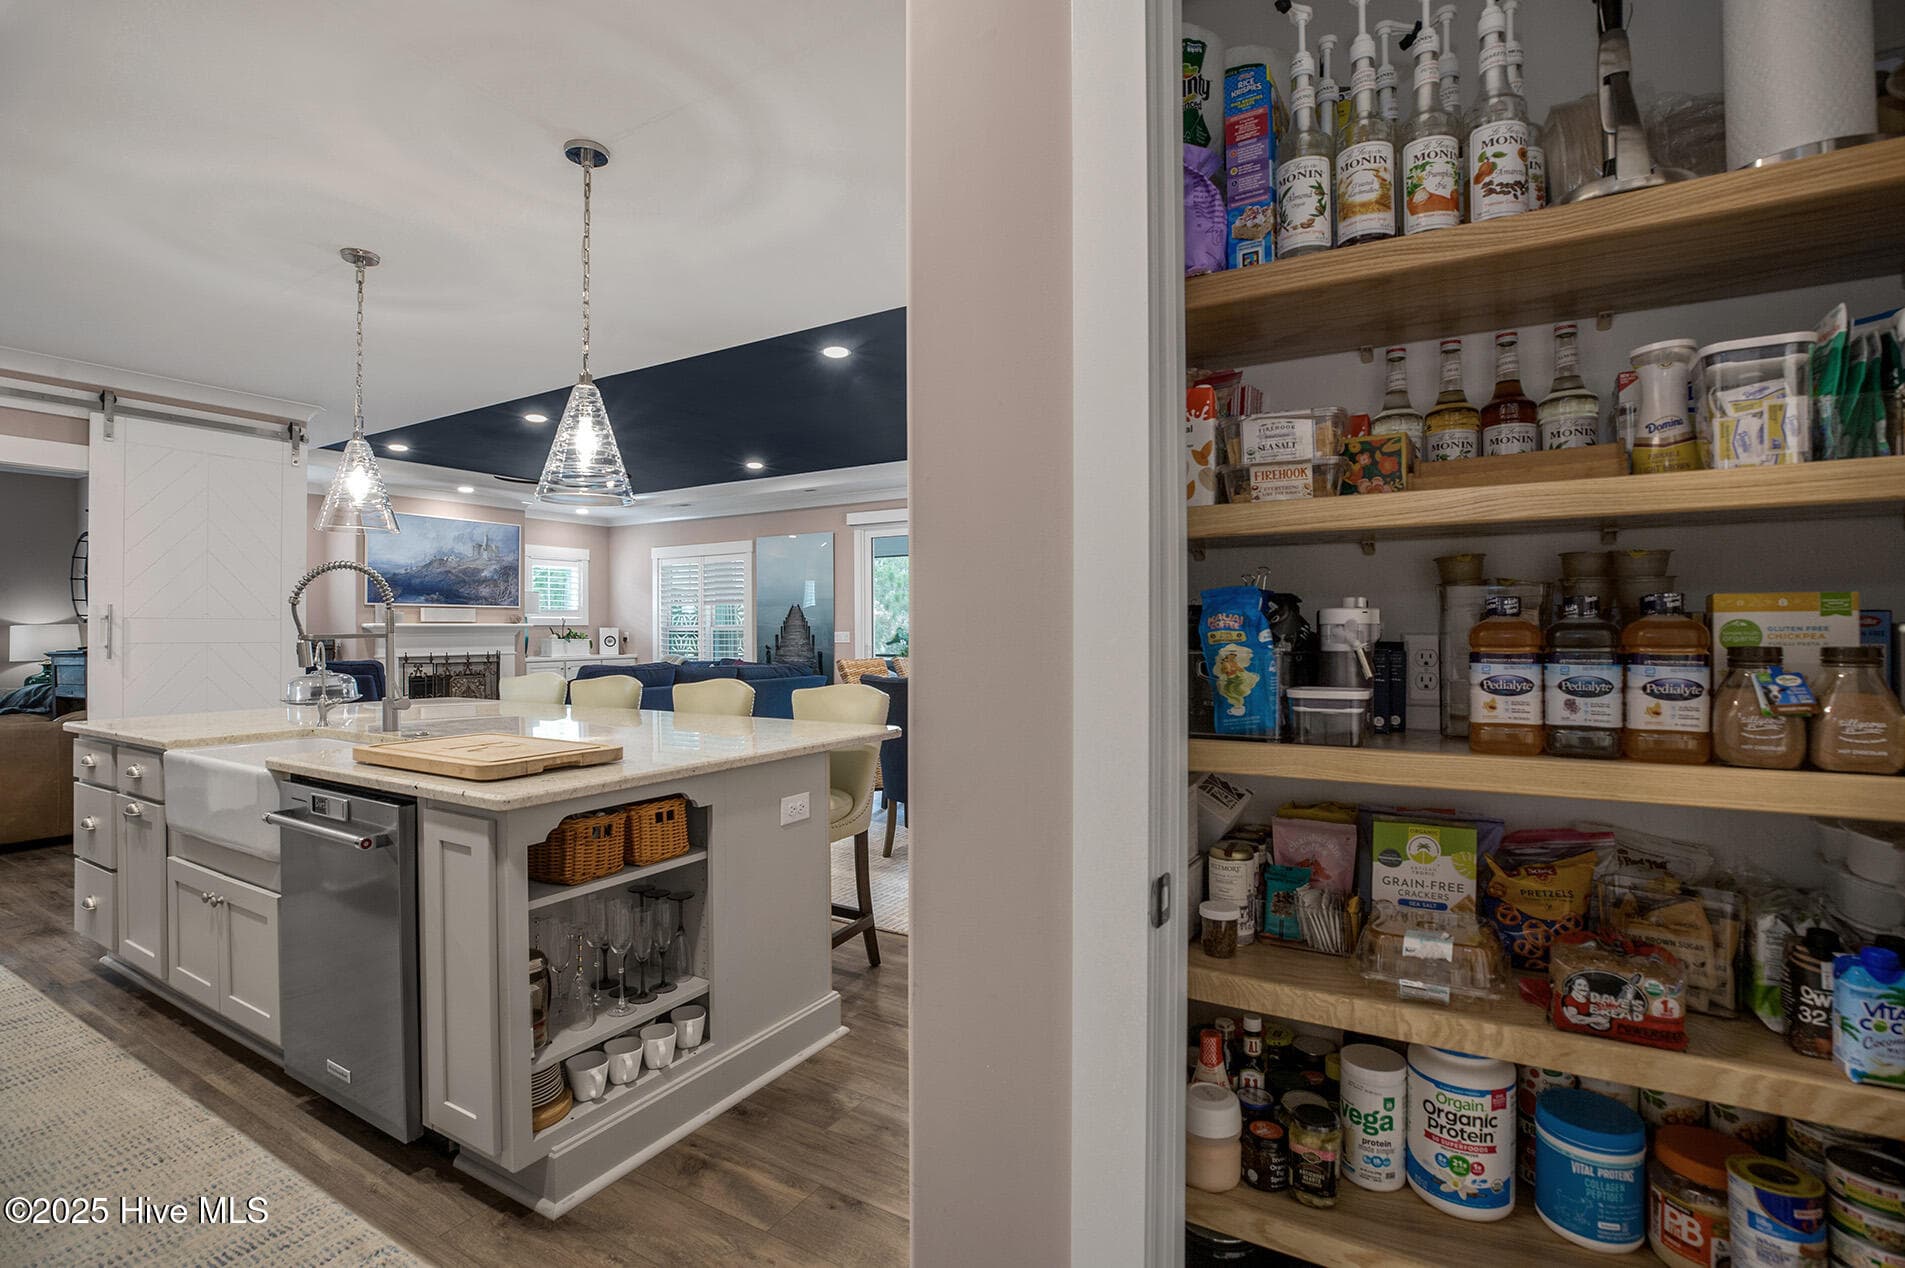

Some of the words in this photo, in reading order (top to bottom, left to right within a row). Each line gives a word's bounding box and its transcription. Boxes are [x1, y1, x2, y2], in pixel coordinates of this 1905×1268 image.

[1230, 82, 1262, 98] KRISPIES
[1237, 78, 1255, 89] RICE
[1340, 155, 1387, 173] MONIN
[1278, 169, 1323, 187] MONIN
[1258, 423, 1297, 434] FIREHOOK
[1550, 426, 1598, 440] MONIN
[1258, 443, 1275, 453] SEA
[1274, 441, 1298, 451] SALT
[1431, 440, 1474, 452] MONIN
[1489, 435, 1535, 447] MONIN
[1253, 467, 1308, 482] FIREHOOK
[1766, 632, 1826, 640] CHICKPEA
[1482, 679, 1534, 692] Pedialyte
[1560, 680, 1614, 694] Pedialyte
[1645, 683, 1704, 697] Pedialyte
[1382, 875, 1465, 894] GRAIN-FREE
[1397, 888, 1450, 901] CRACKERS
[1519, 888, 1575, 898] PRETZELS
[1644, 935, 1677, 947] BROWN
[1797, 1005, 1830, 1028] 32
[1435, 1091, 1484, 1112] Orgain
[1340, 1097, 1394, 1136] vega
[1422, 1099, 1498, 1129] Organic
[1427, 1116, 1494, 1143] Protein
[1361, 1137, 1392, 1149] protein
[1441, 1138, 1489, 1154] SUPERFOODS
[1570, 1159, 1596, 1177] VITAL
[1597, 1167, 1635, 1184] PROTEINS
[1584, 1177, 1626, 1193] COLLAGEN
[1585, 1188, 1625, 1202] PEPTIDES
[1664, 1203, 1704, 1248] PB
